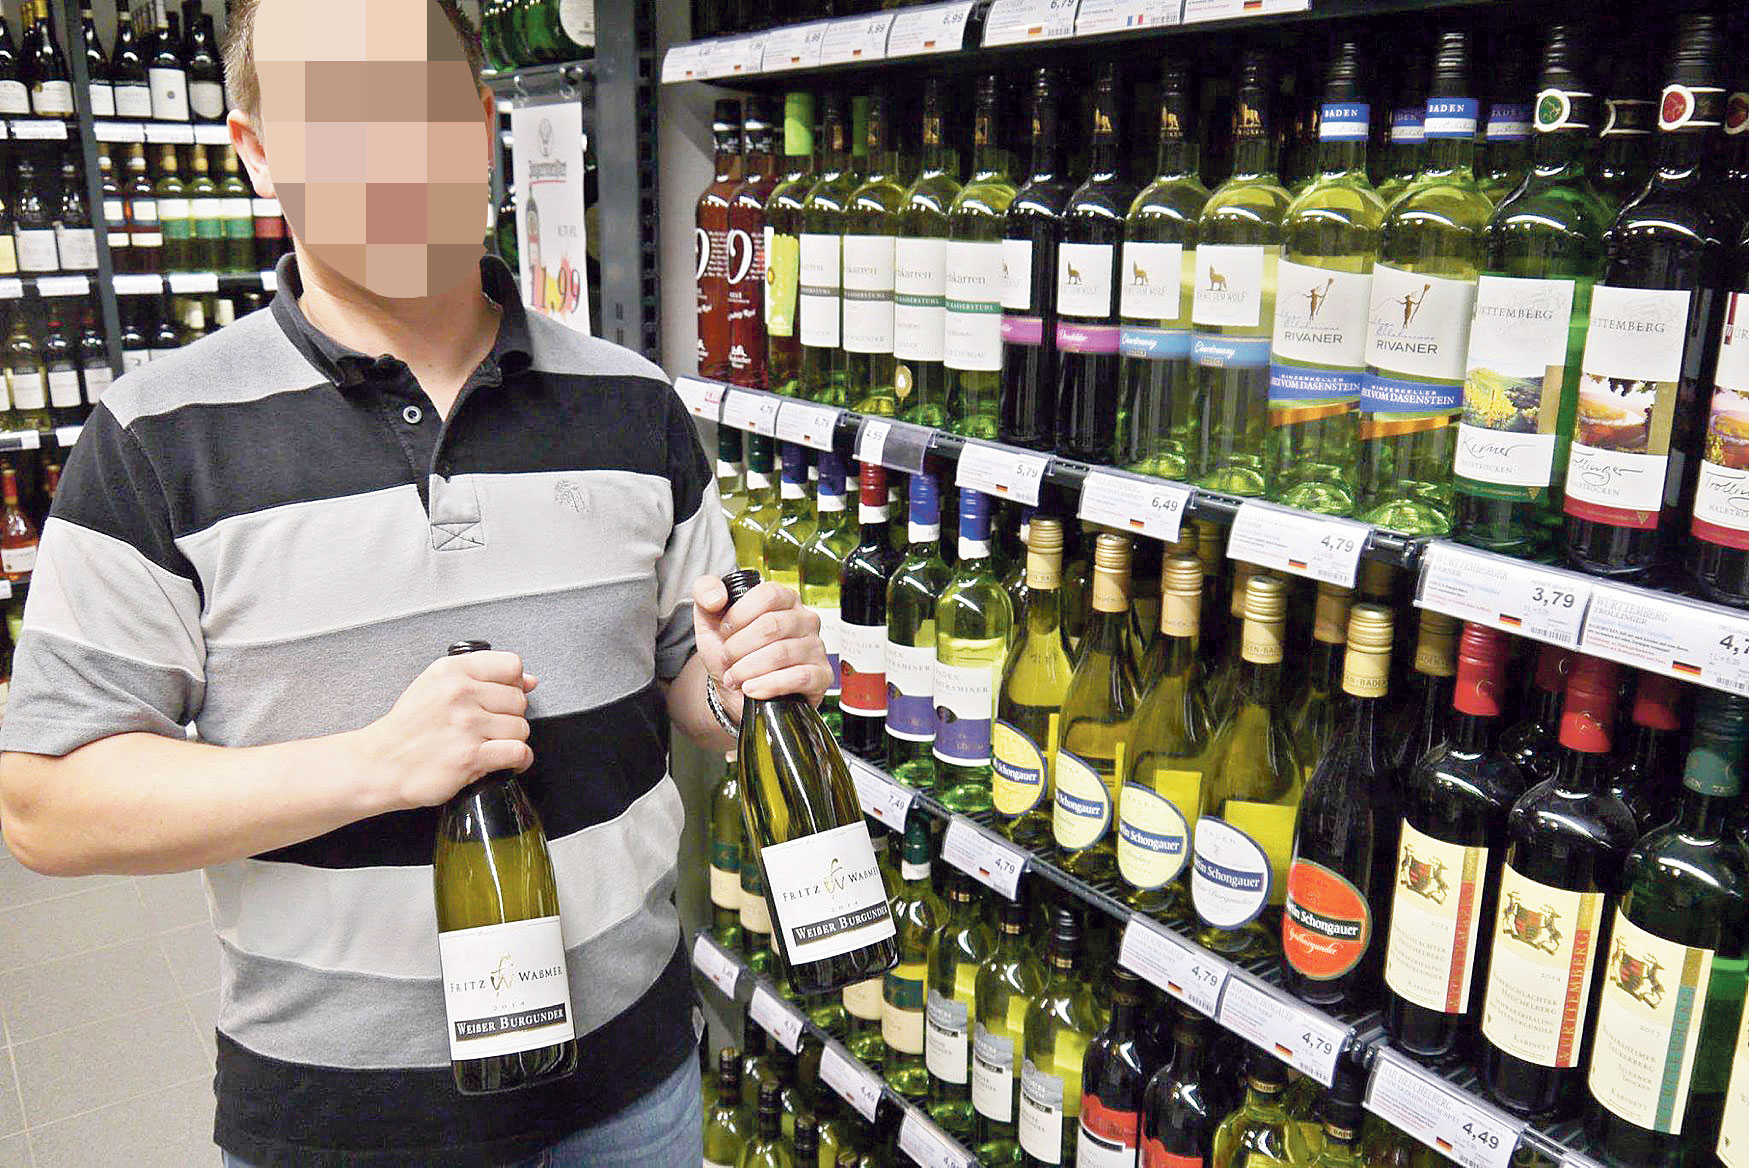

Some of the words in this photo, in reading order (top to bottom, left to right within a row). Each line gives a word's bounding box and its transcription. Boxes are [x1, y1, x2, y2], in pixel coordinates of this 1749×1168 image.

[1324, 108, 1358, 118] BADEN
[1428, 103, 1465, 114] BADEN
[1284, 331, 1343, 344] RIVANER
[1376, 339, 1438, 355] RIVANER
[1300, 378, 1361, 392] DASENSTEIN
[1390, 392, 1455, 405] DASENSTEIN
[1016, 464, 1038, 478] 5,79
[1151, 496, 1178, 512] 6,49
[1320, 533, 1355, 553] 4,79
[1532, 587, 1575, 609] 3,79
[1130, 828, 1180, 852] Schongauer
[995, 858, 1016, 875] 4,79
[1207, 862, 1260, 890] Schongauer
[782, 884, 821, 902] FRITZ
[1301, 908, 1358, 936] Schongauer
[1192, 966, 1219, 987] 4,79
[450, 979, 486, 994] FRITZ
[499, 1008, 565, 1030] BURGUNDER
[1302, 1031, 1333, 1056] 4,79
[1462, 1122, 1500, 1150] 4,49
